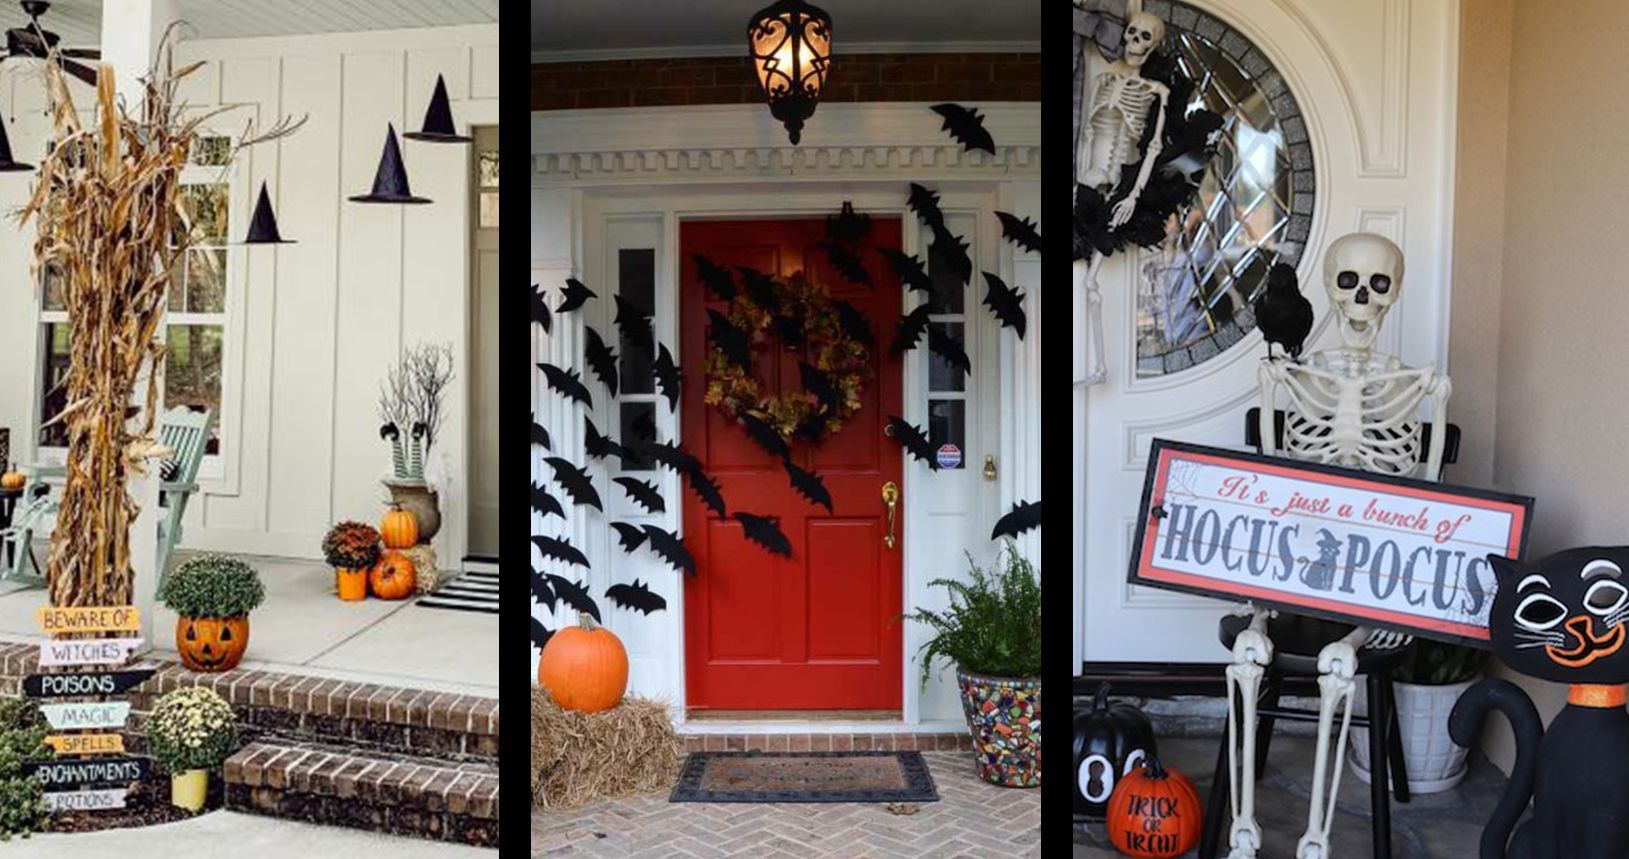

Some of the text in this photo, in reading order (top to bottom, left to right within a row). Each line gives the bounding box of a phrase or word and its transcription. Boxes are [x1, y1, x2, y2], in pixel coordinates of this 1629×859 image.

[1218, 475, 1471, 543] It's just a bunch of
[1160, 502, 1492, 616] HOCUS POCUS
[44, 610, 133, 628] BEWARE OF
[52, 643, 121, 661] WITCHES
[42, 675, 115, 694] POISONS
[62, 707, 118, 723] MAGIC
[63, 735, 115, 750] SPELLS
[40, 762, 140, 783] ENCHANTMENTS
[56, 793, 114, 808] POTIONS
[1128, 795, 1180, 818] TRICK
[1143, 818, 1162, 833] OR
